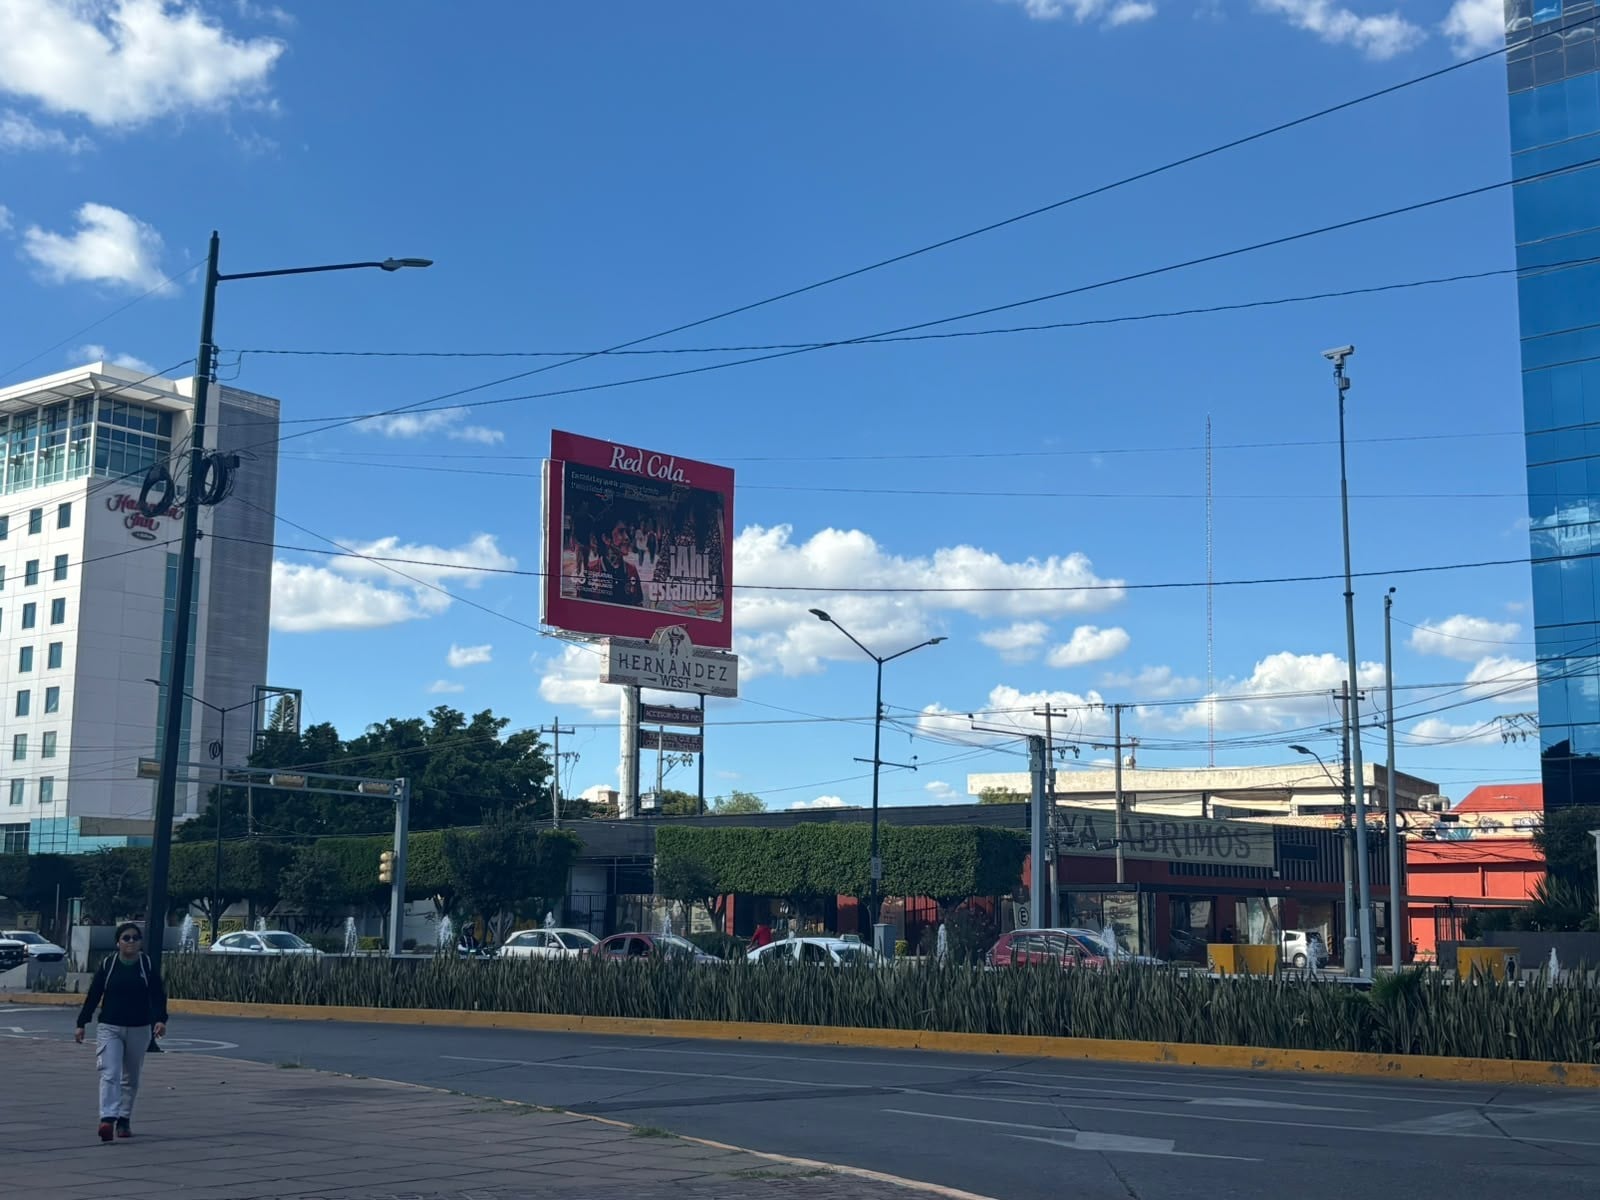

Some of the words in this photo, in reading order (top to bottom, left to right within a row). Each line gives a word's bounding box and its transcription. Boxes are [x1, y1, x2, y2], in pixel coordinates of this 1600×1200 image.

[609, 446, 643, 474] Red
[647, 455, 685, 482] Cola
[650, 575, 717, 601] estamos!
[660, 674, 691, 689] WEST
[1118, 818, 1250, 859] ABRIMOS
[1020, 910, 1027, 923] E
